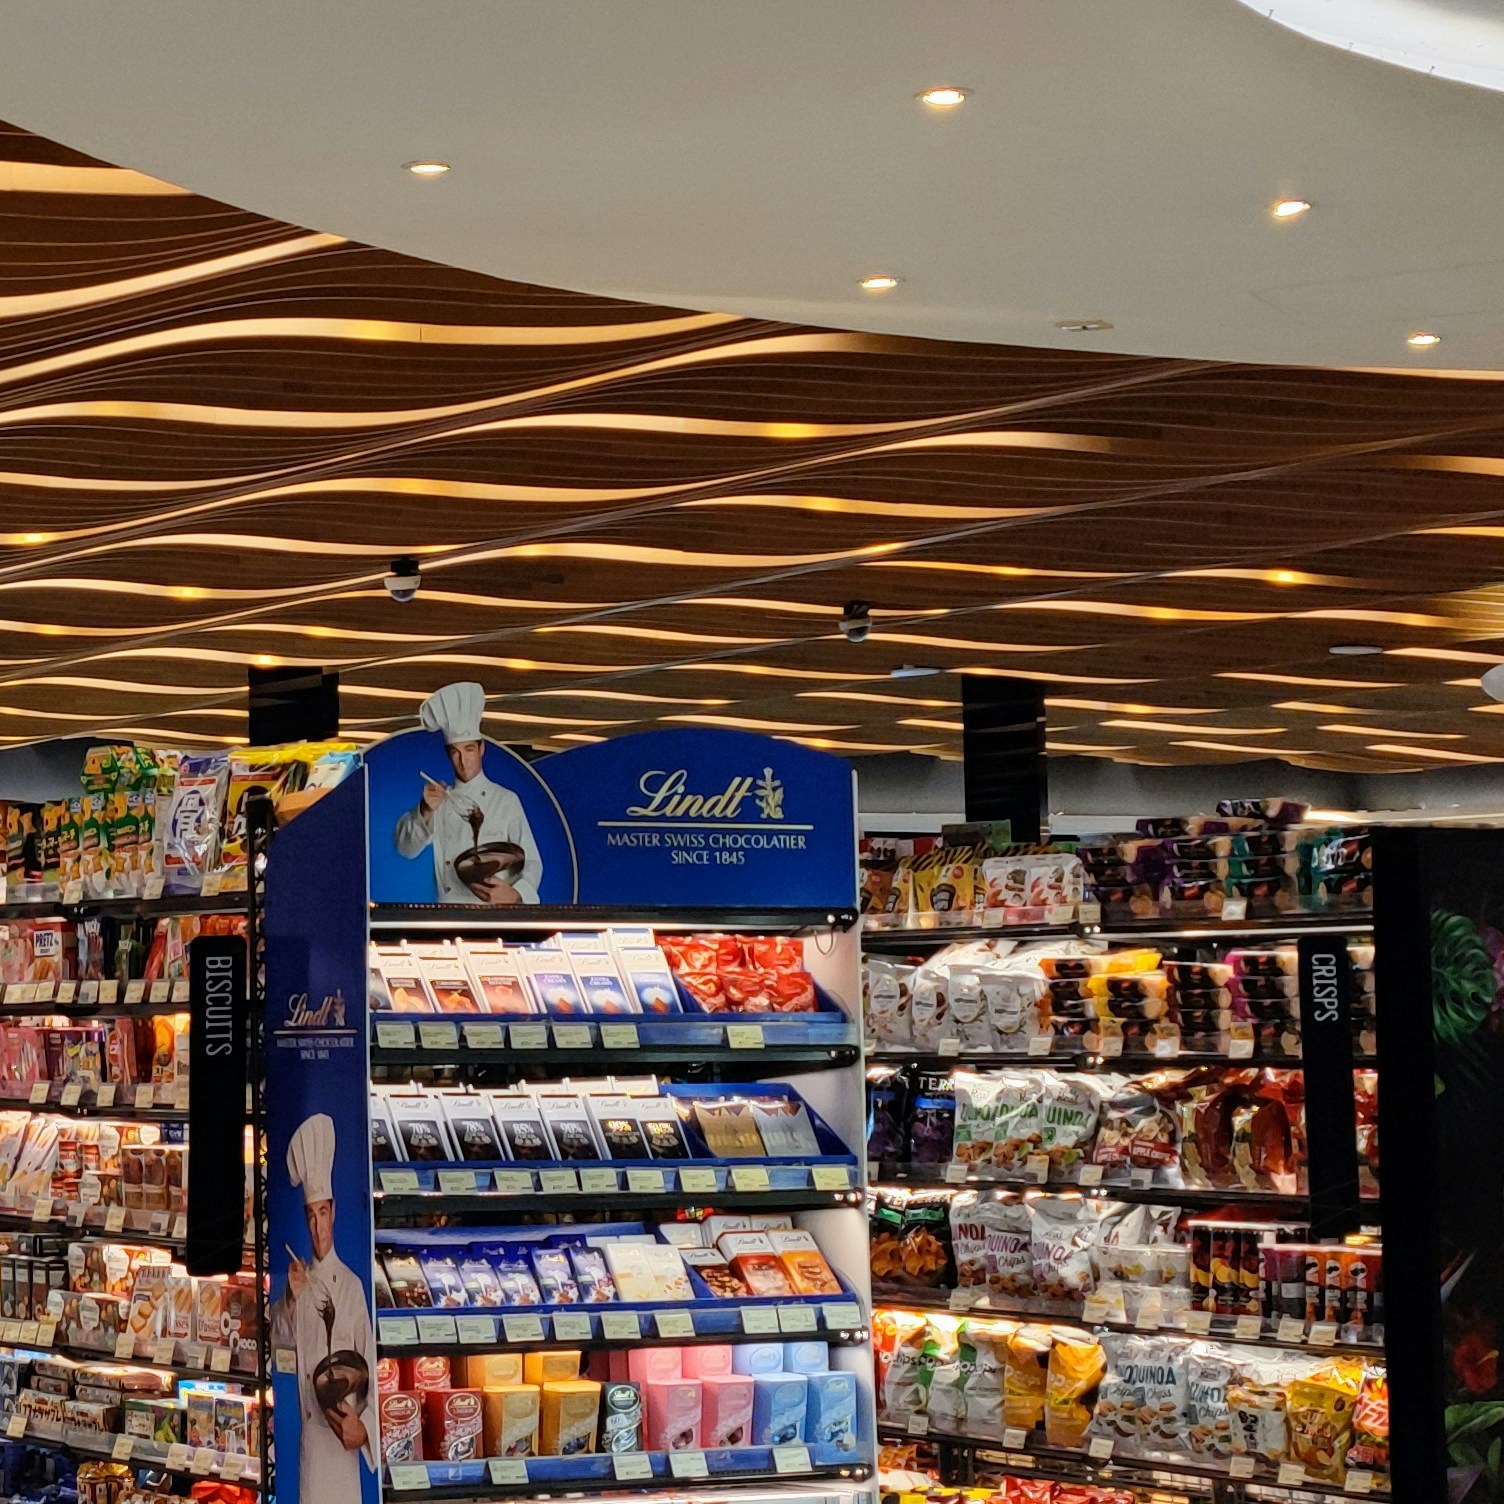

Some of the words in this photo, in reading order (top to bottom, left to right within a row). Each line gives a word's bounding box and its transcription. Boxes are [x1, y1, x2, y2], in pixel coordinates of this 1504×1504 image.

[627, 769, 755, 820] Lindt
[607, 832, 662, 849] MASTER
[664, 832, 706, 849] SWISS
[708, 832, 807, 850] CHOCOLATIER
[671, 850, 711, 865] SINCE
[713, 850, 745, 865] 1845
[35, 931, 54, 948] PRETZ
[1311, 953, 1338, 1023] CRISPS
[205, 956, 232, 1056] BISCUITS
[284, 992, 336, 1028] Lindt
[409, 1122, 431, 1134] 70%
